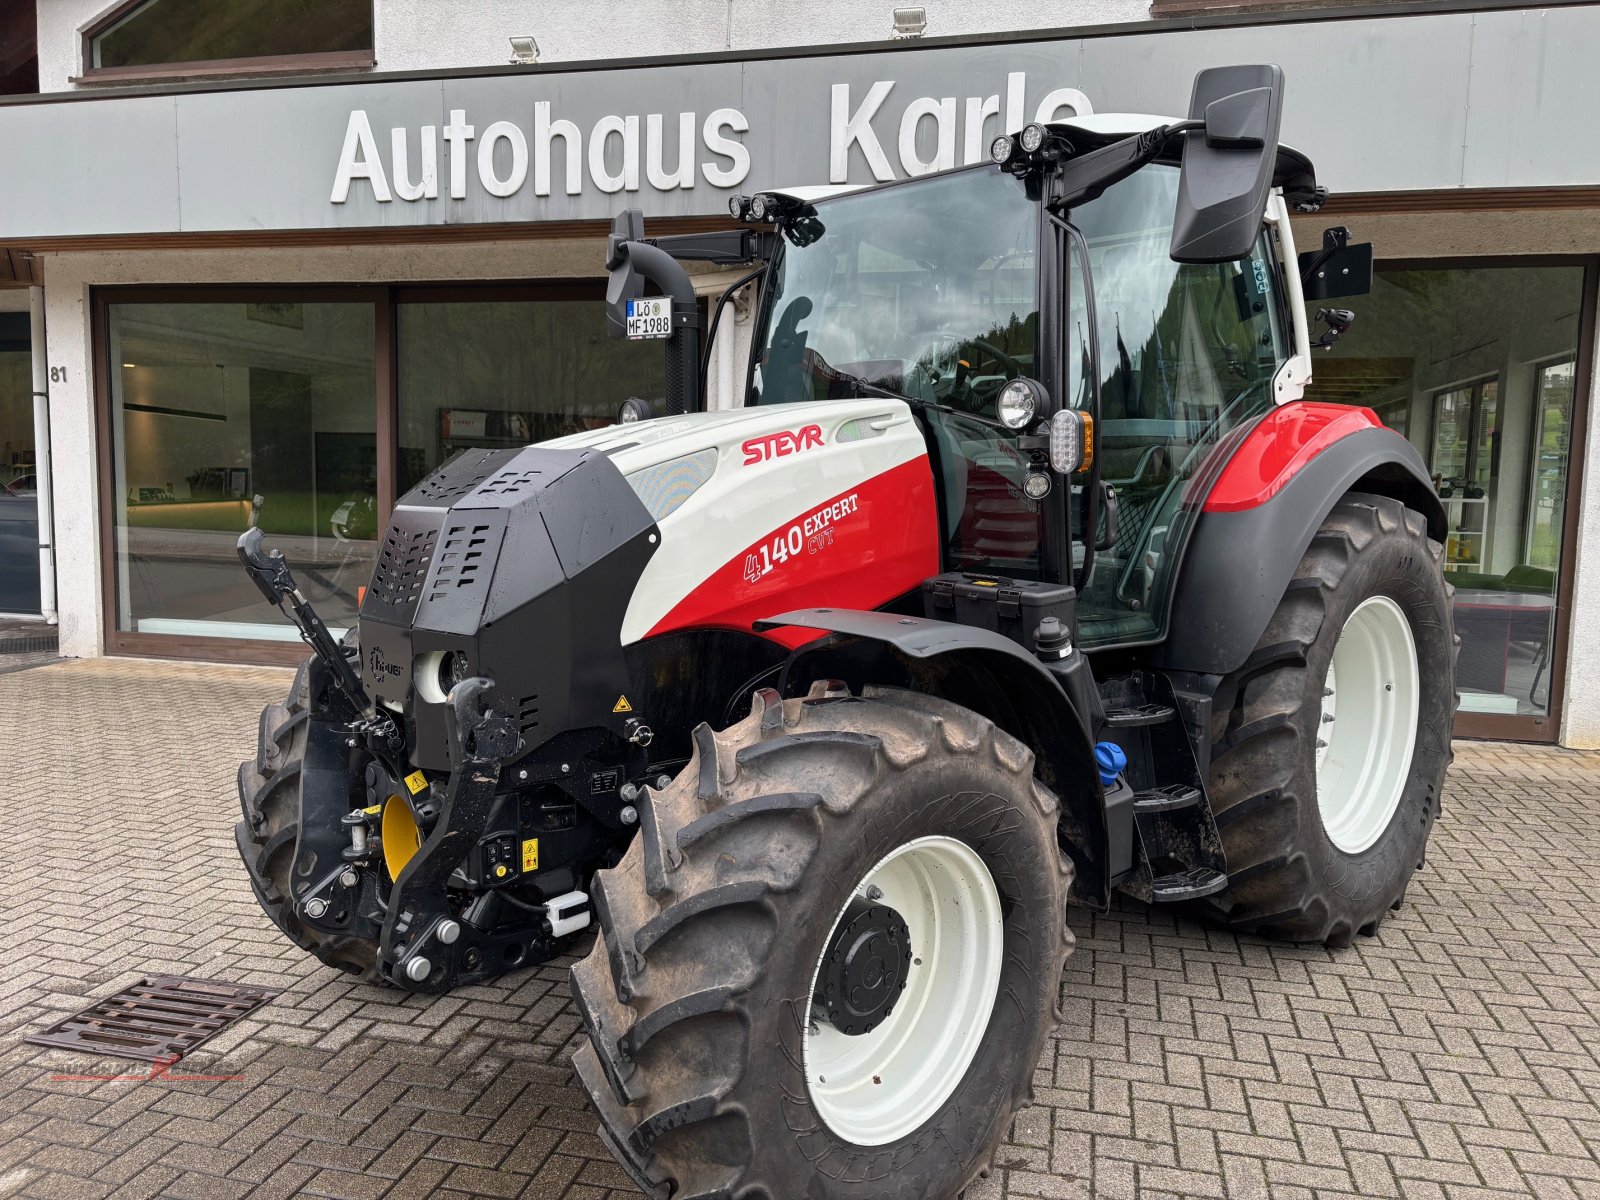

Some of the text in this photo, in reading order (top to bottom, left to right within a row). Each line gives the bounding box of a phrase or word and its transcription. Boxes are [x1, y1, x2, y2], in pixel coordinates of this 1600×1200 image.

[330, 101, 751, 203] Autohaus
[636, 301, 650, 317] LÖ
[51, 366, 67, 383] 81
[741, 424, 825, 466] STEYR
[803, 493, 858, 537] EXPERT
[808, 526, 834, 554] CVT
